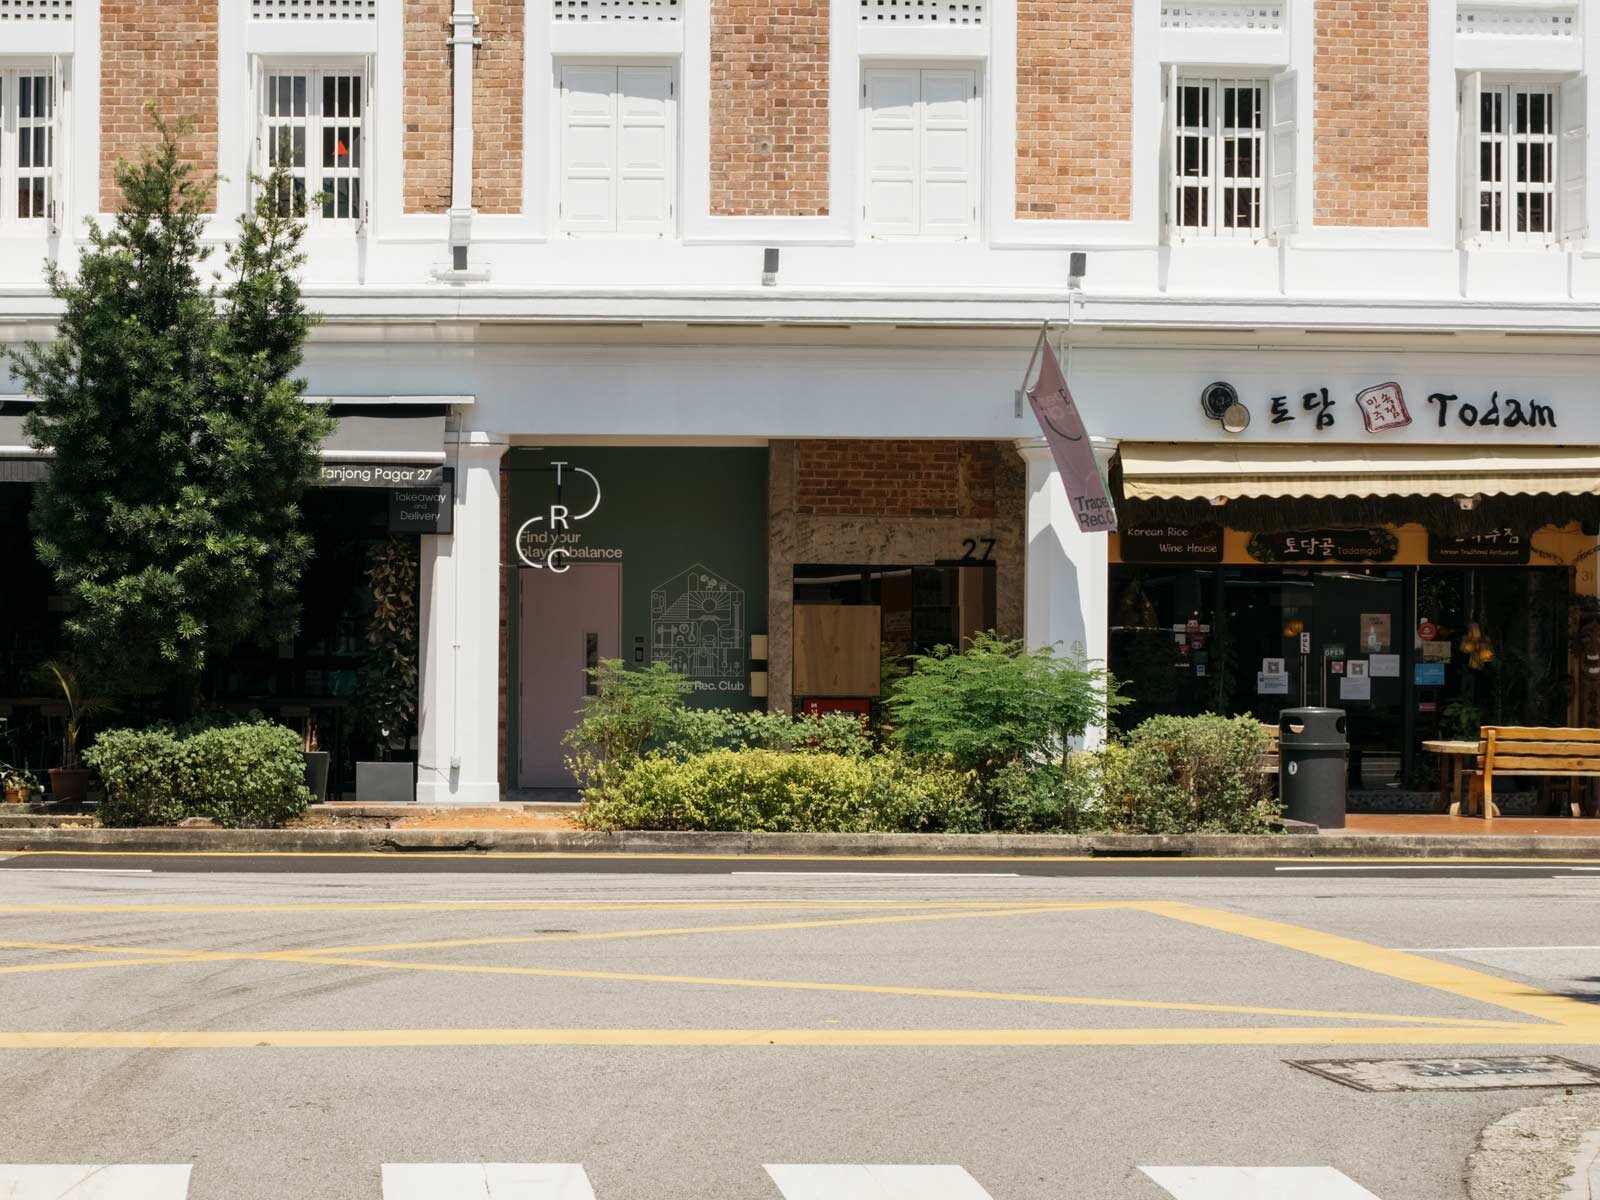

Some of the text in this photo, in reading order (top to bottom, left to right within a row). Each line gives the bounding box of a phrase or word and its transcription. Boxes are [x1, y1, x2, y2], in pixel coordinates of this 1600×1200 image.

[1271, 387, 1335, 431] 토담
[1427, 390, 1557, 428] Todam
[374, 467, 415, 482] Pagar
[417, 469, 432, 481] 27
[394, 491, 447, 504] Takeaway
[400, 510, 441, 523] Delivery
[1127, 527, 1189, 537] Korean Rice
[568, 545, 623, 559] balance
[961, 538, 996, 561] 27
[1159, 543, 1218, 553] Wine House
[1324, 647, 1345, 657] OPEN
[718, 680, 745, 691] Club
